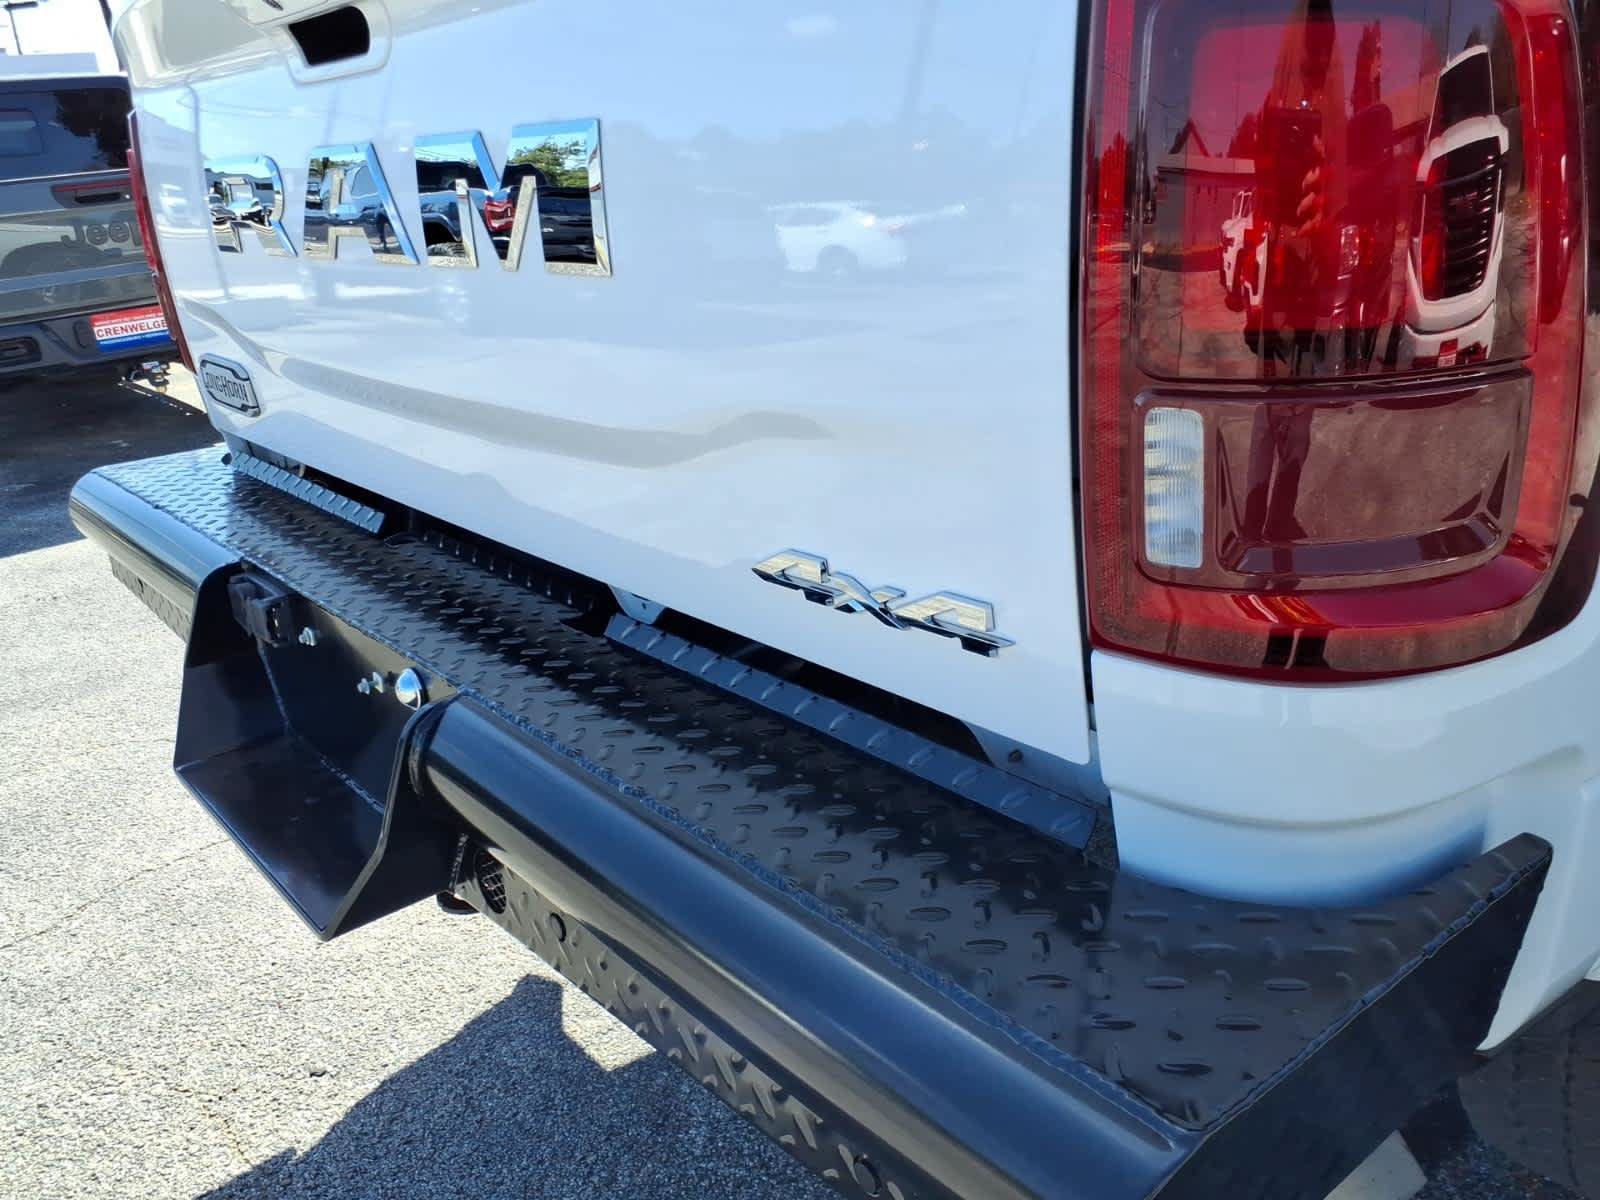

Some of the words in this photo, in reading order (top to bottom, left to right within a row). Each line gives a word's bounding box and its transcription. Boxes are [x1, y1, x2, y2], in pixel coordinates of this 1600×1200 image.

[202, 117, 614, 279] RAM
[95, 319, 169, 339] CRENWELGE
[202, 370, 249, 402] LONGHORN
